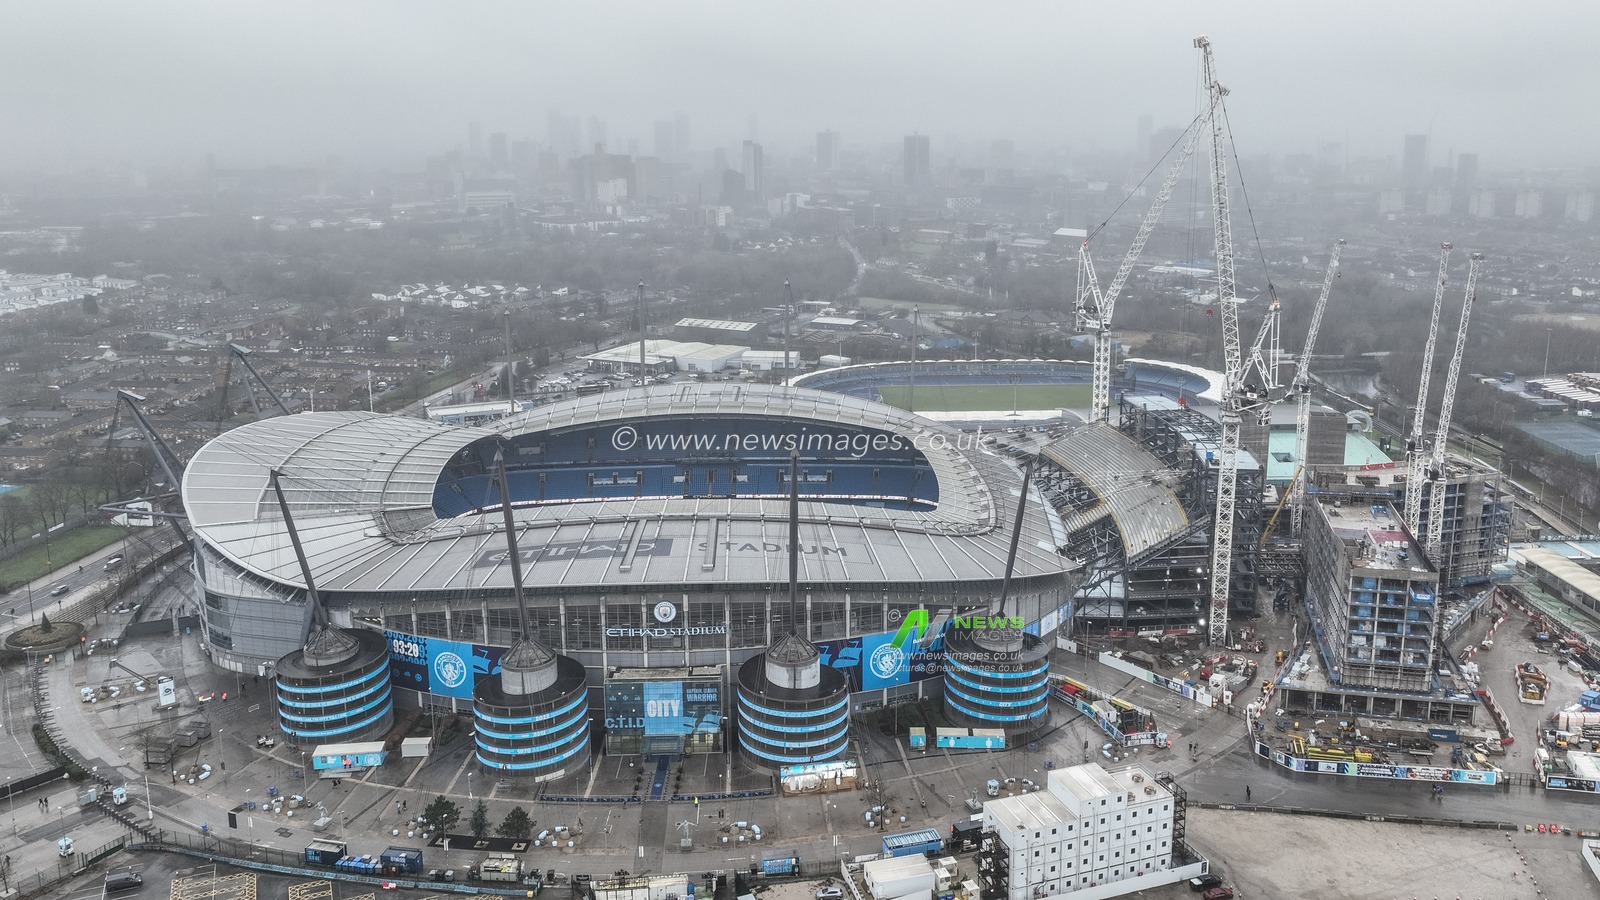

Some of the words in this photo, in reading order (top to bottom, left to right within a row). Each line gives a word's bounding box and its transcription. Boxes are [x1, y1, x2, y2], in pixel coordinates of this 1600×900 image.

[698, 541, 848, 557] STADIUM
[606, 628, 667, 637] ETIHAD
[669, 626, 726, 636] STADIUM
[393, 639, 419, 658] 93:20
[686, 694, 718, 702] WARRIOR
[646, 700, 680, 718] CITY
